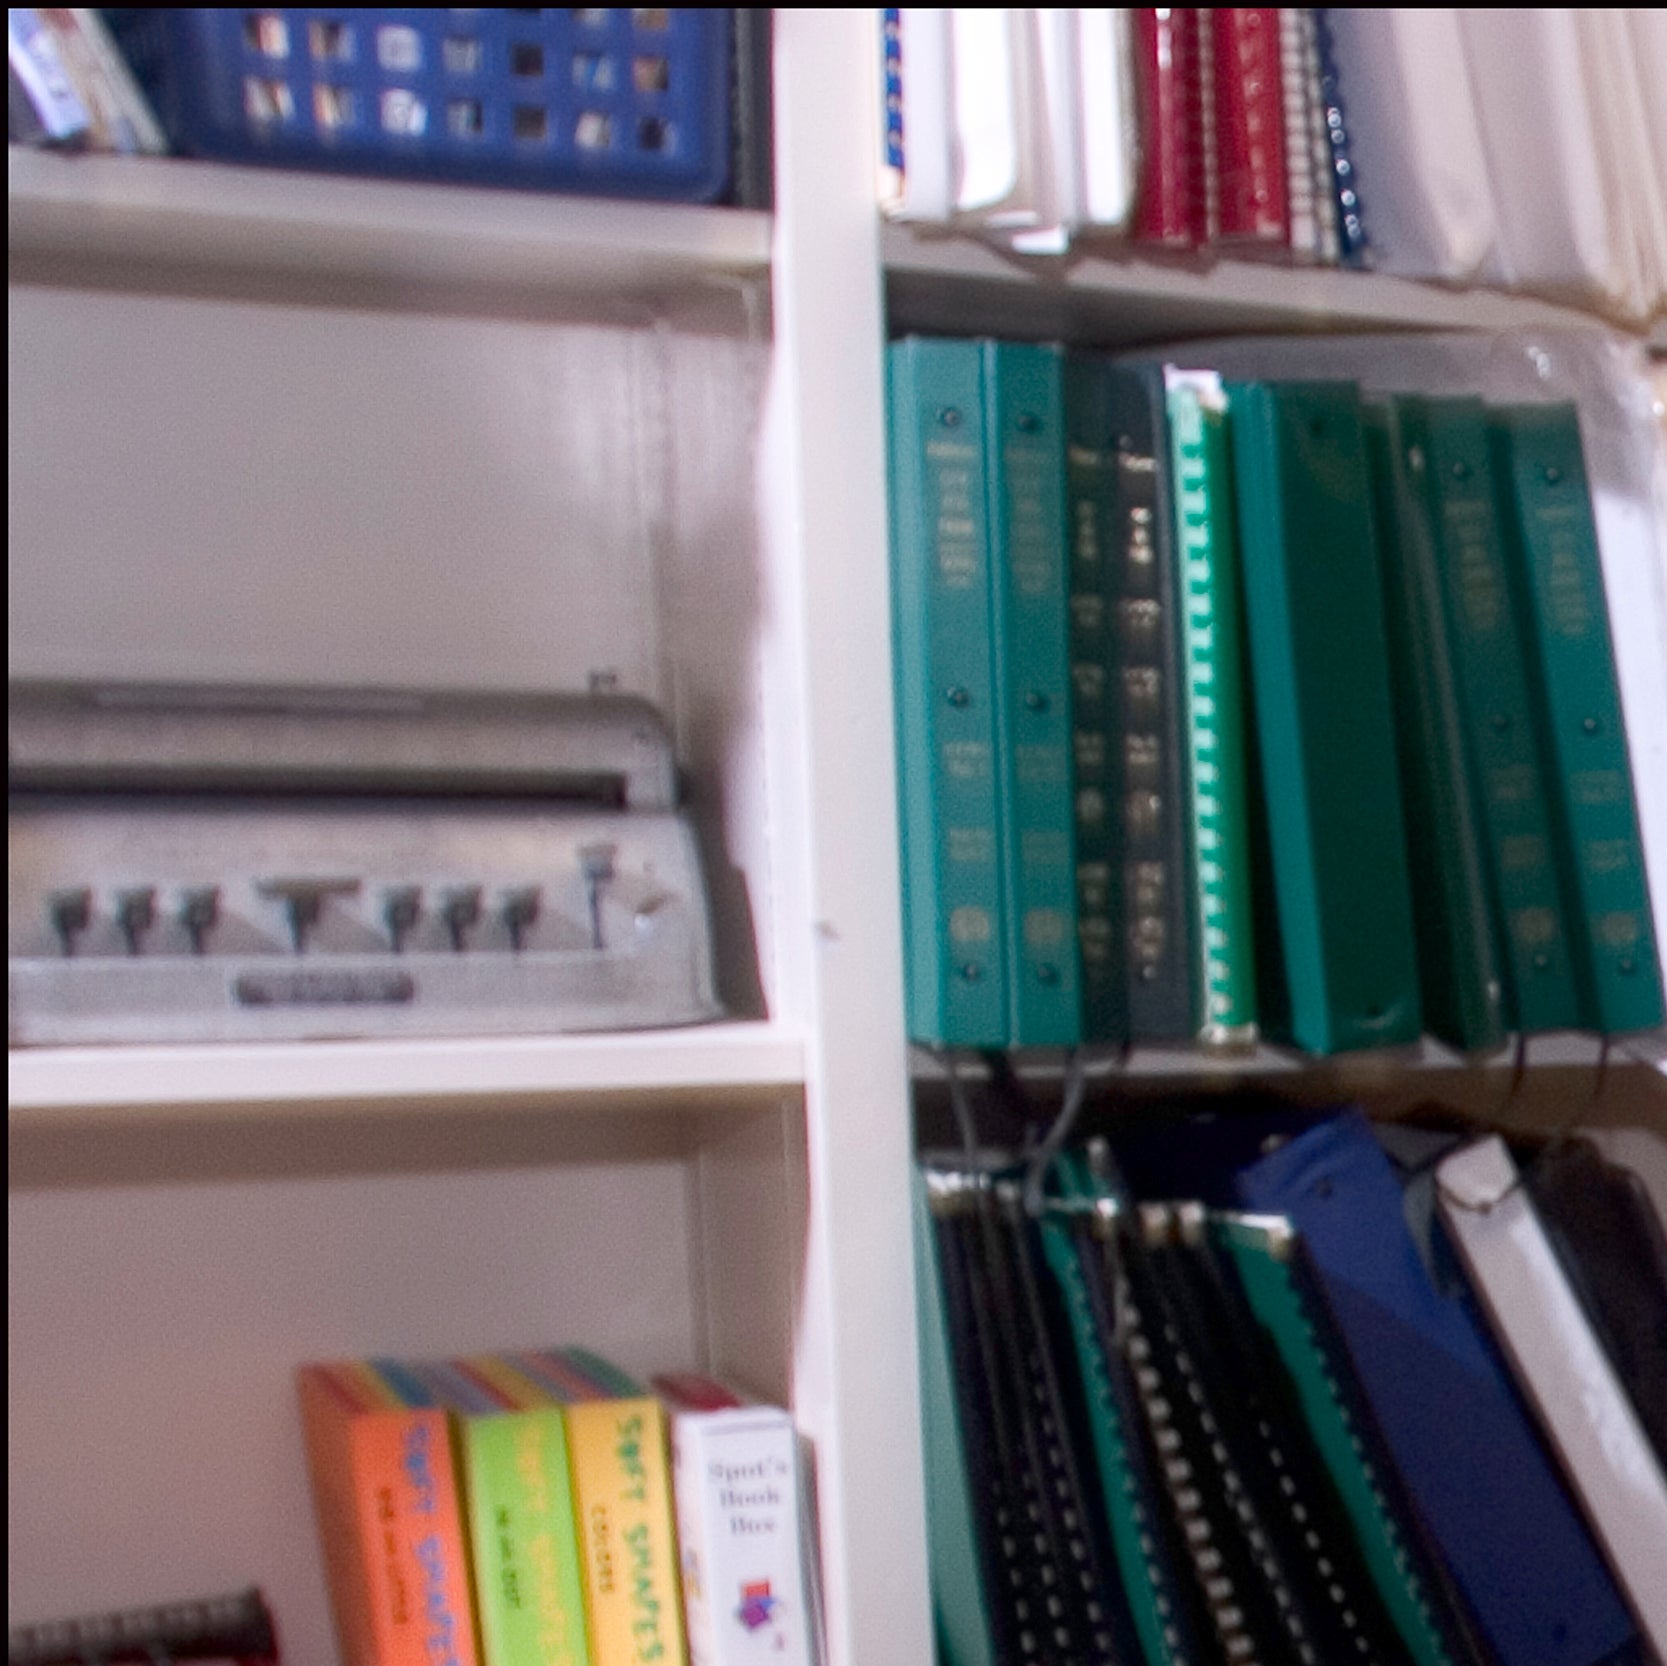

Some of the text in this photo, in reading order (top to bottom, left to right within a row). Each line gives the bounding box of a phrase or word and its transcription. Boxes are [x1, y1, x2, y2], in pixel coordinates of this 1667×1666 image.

[719, 1485, 780, 1509] Book
[730, 1516, 777, 1537] Box
[614, 1413, 665, 1666] SOFT SHAPES
